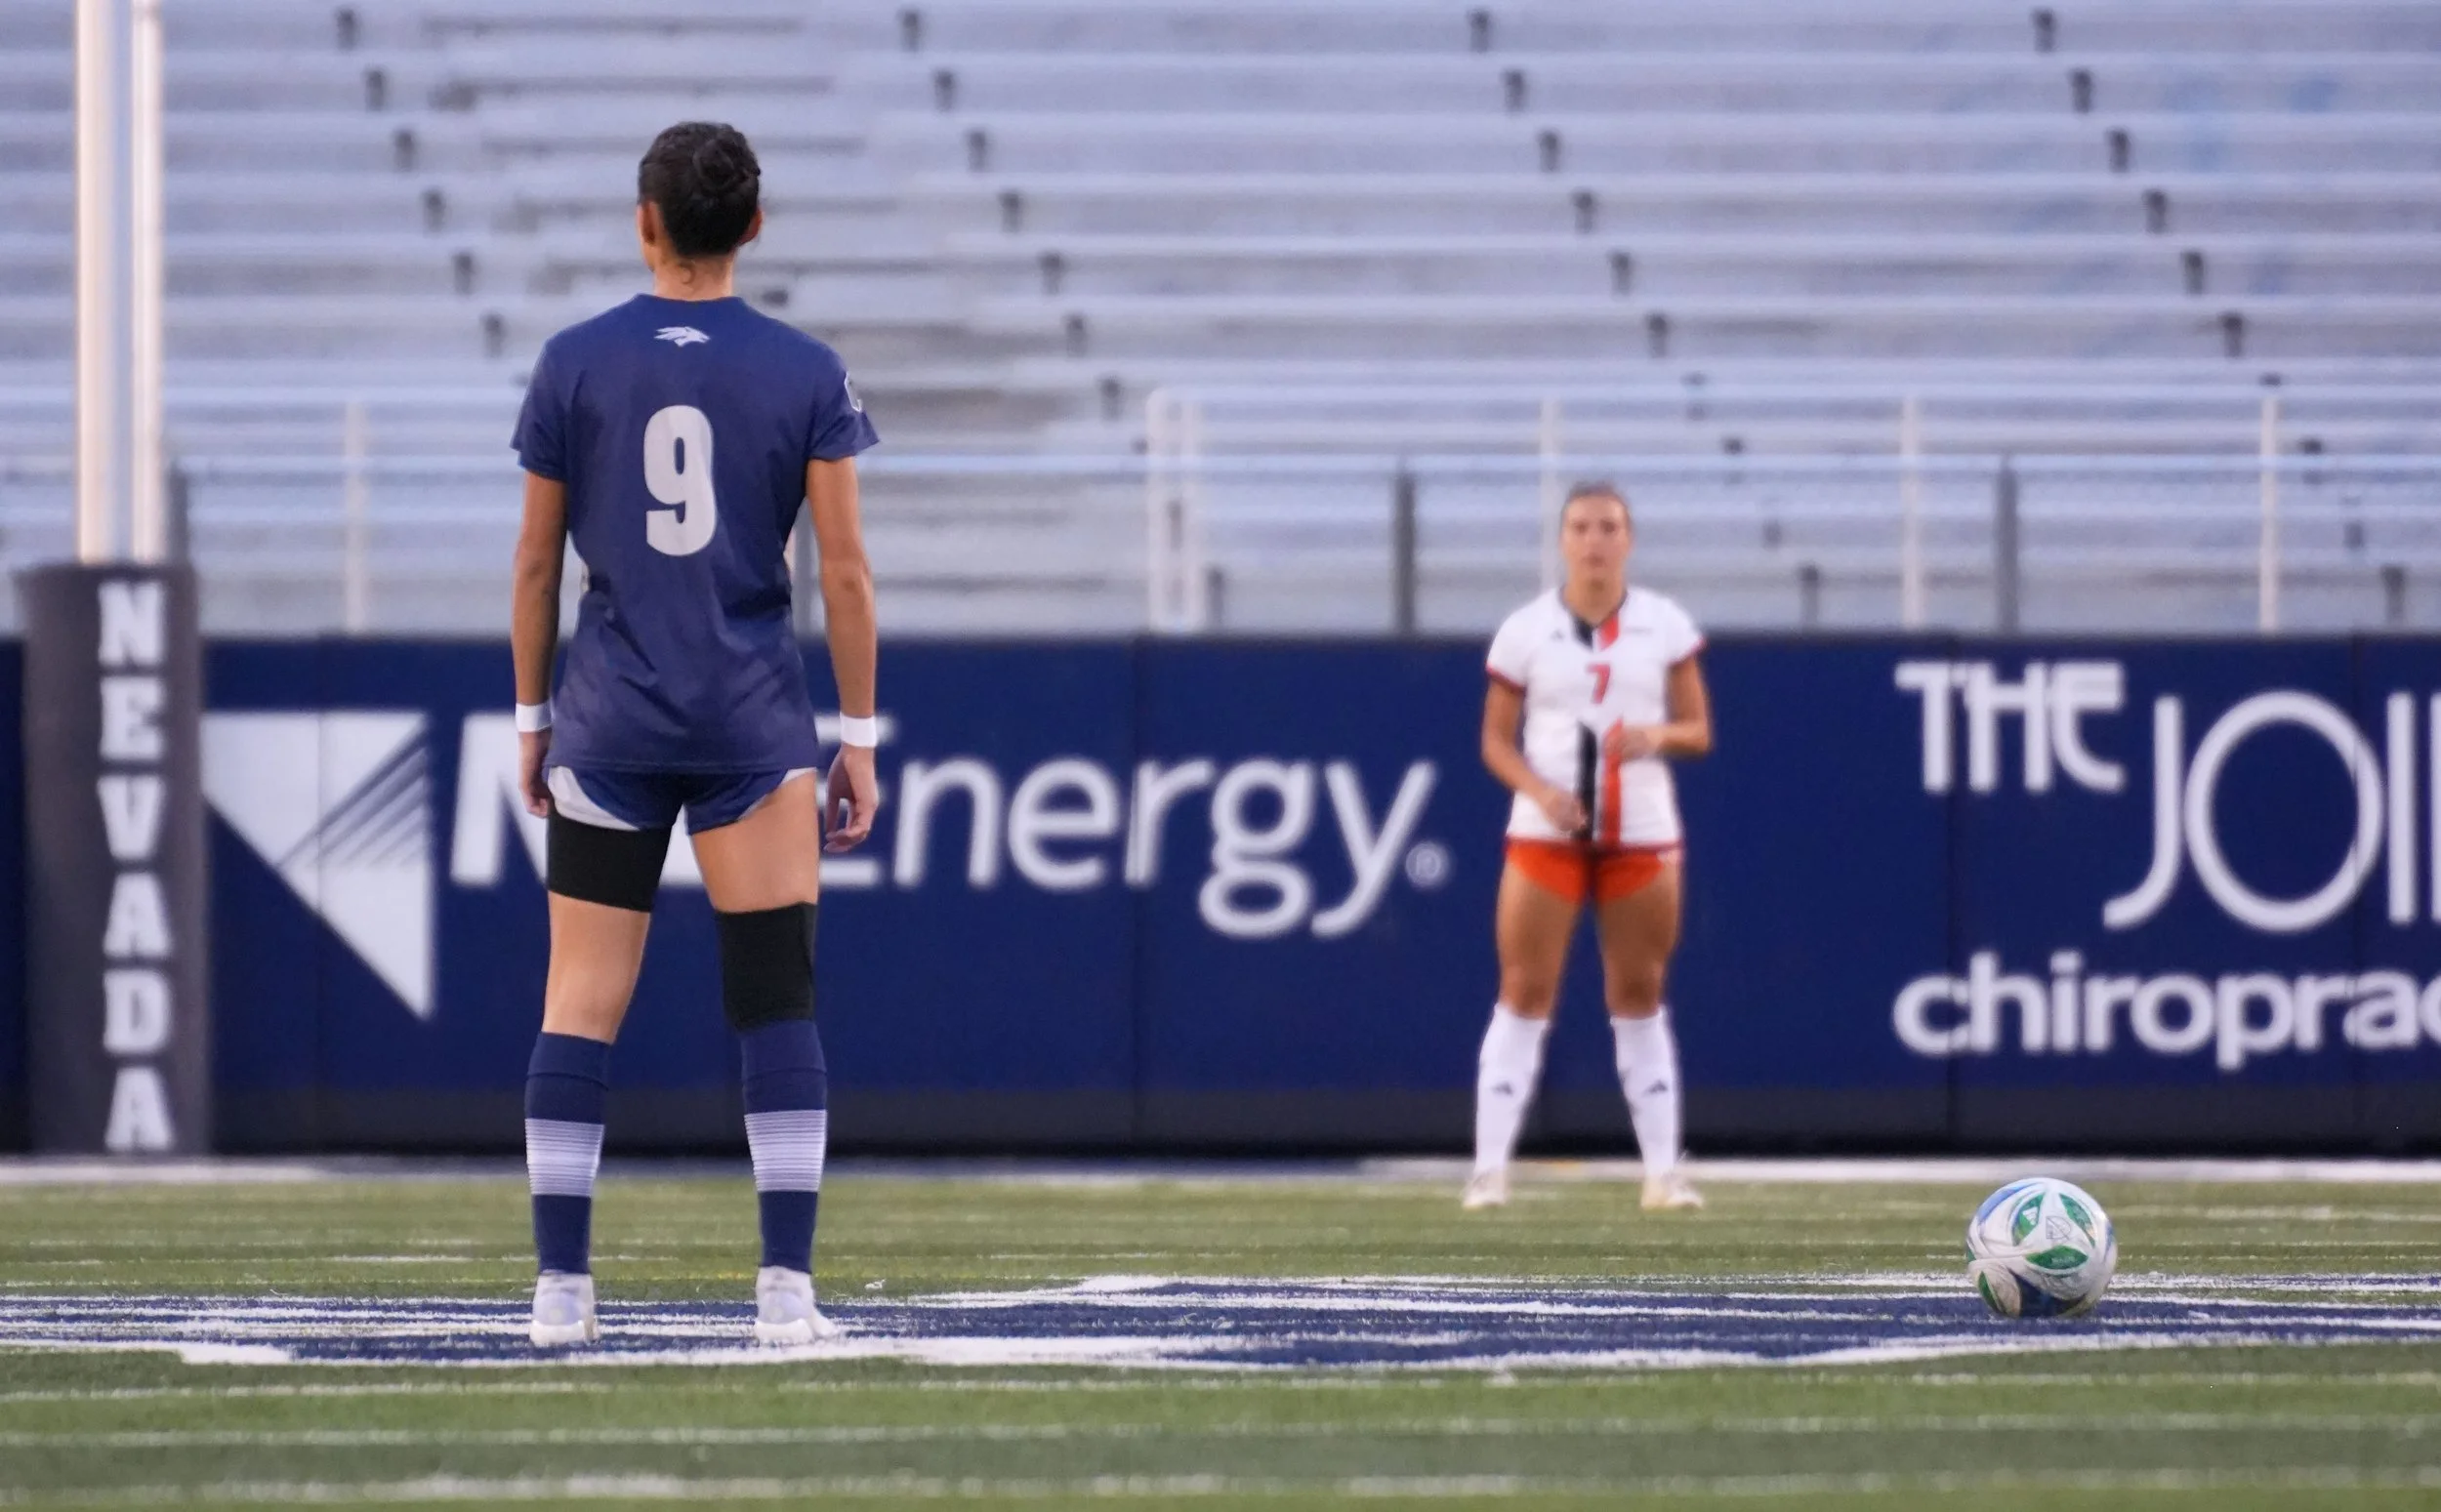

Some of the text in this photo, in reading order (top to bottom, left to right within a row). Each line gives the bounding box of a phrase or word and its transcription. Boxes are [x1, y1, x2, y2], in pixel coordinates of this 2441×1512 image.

[643, 404, 717, 556] 9
[1585, 662, 1611, 704] 7
[1895, 661, 2123, 793] THE
[98, 581, 174, 1152] NEVADA
[2103, 691, 2441, 932] JOI
